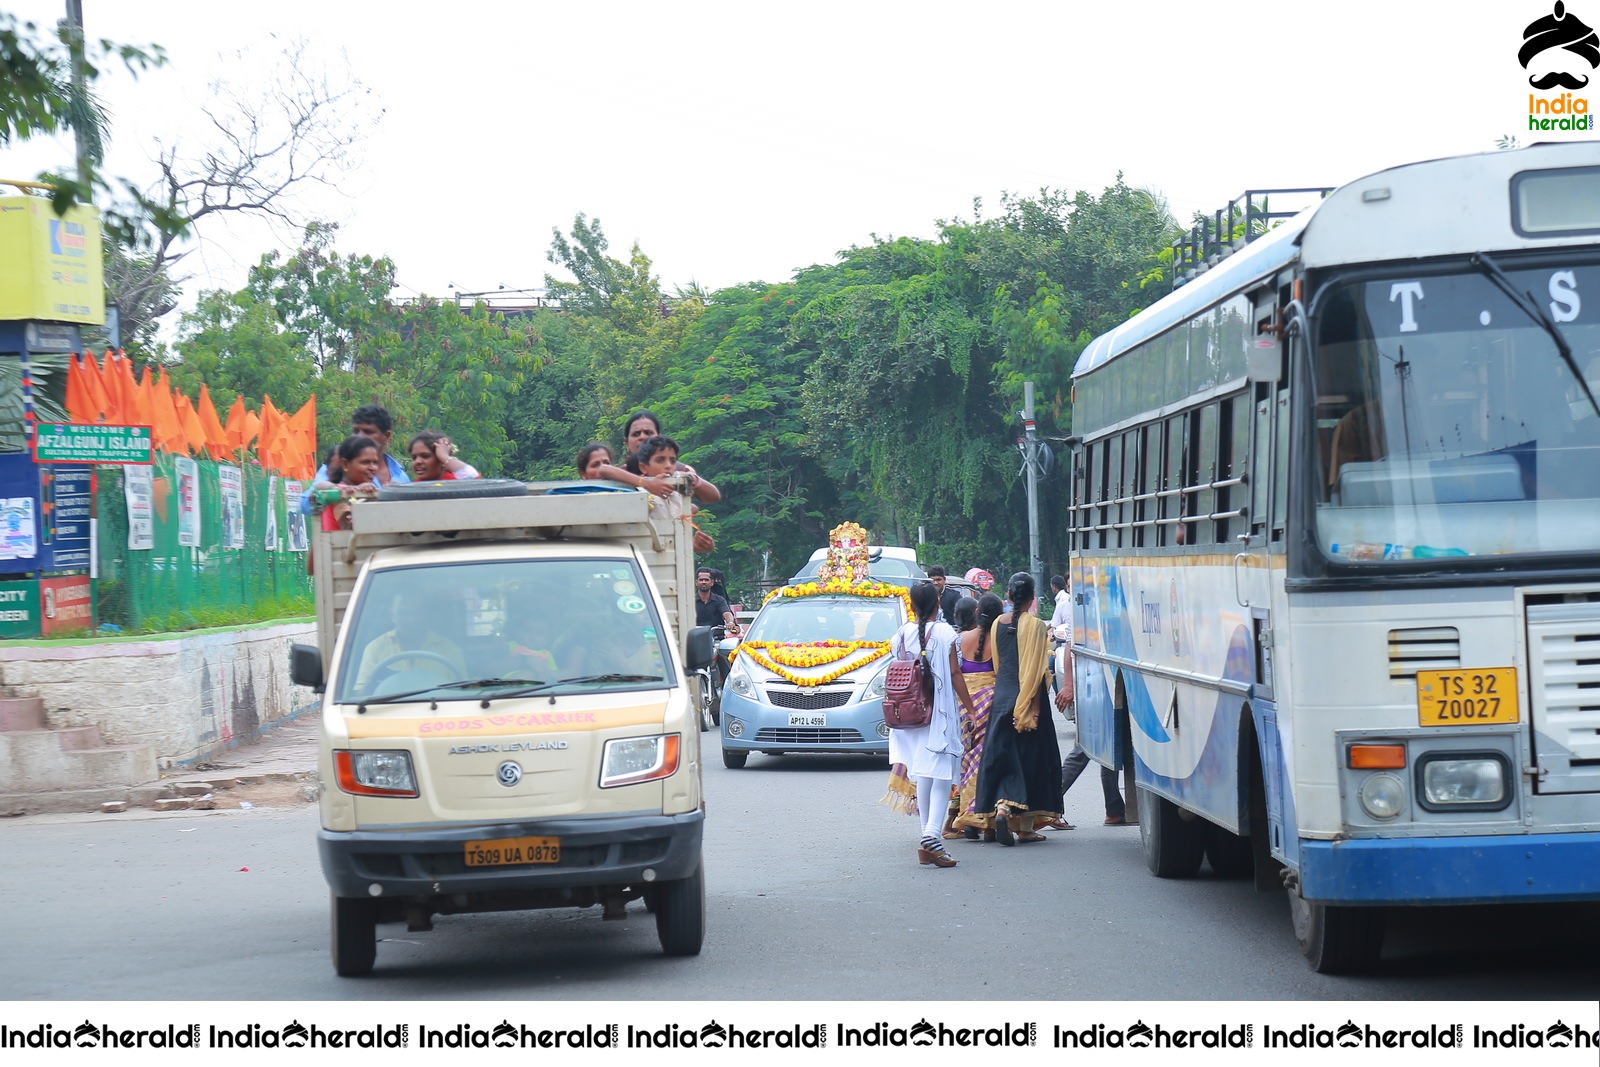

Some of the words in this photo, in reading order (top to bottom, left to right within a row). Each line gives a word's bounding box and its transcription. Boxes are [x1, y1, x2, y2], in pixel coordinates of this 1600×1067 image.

[1389, 281, 1424, 332] T
[1548, 270, 1581, 323] S
[70, 425, 125, 435] WELCOME
[37, 434, 106, 449] AFZALGUNJ
[109, 436, 150, 450] ISLAND
[1439, 675, 1464, 697] TS
[1472, 674, 1497, 695] 32
[1437, 697, 1501, 720] Z0027
[419, 719, 484, 733] GOODS
[517, 712, 597, 727] CARRIER
[790, 717, 805, 726] AP12
[448, 743, 499, 756] ASHOK
[501, 740, 569, 752] LEYLAND
[468, 849, 500, 865] TS09
[504, 847, 522, 862] UA
[527, 846, 559, 861] 0878
